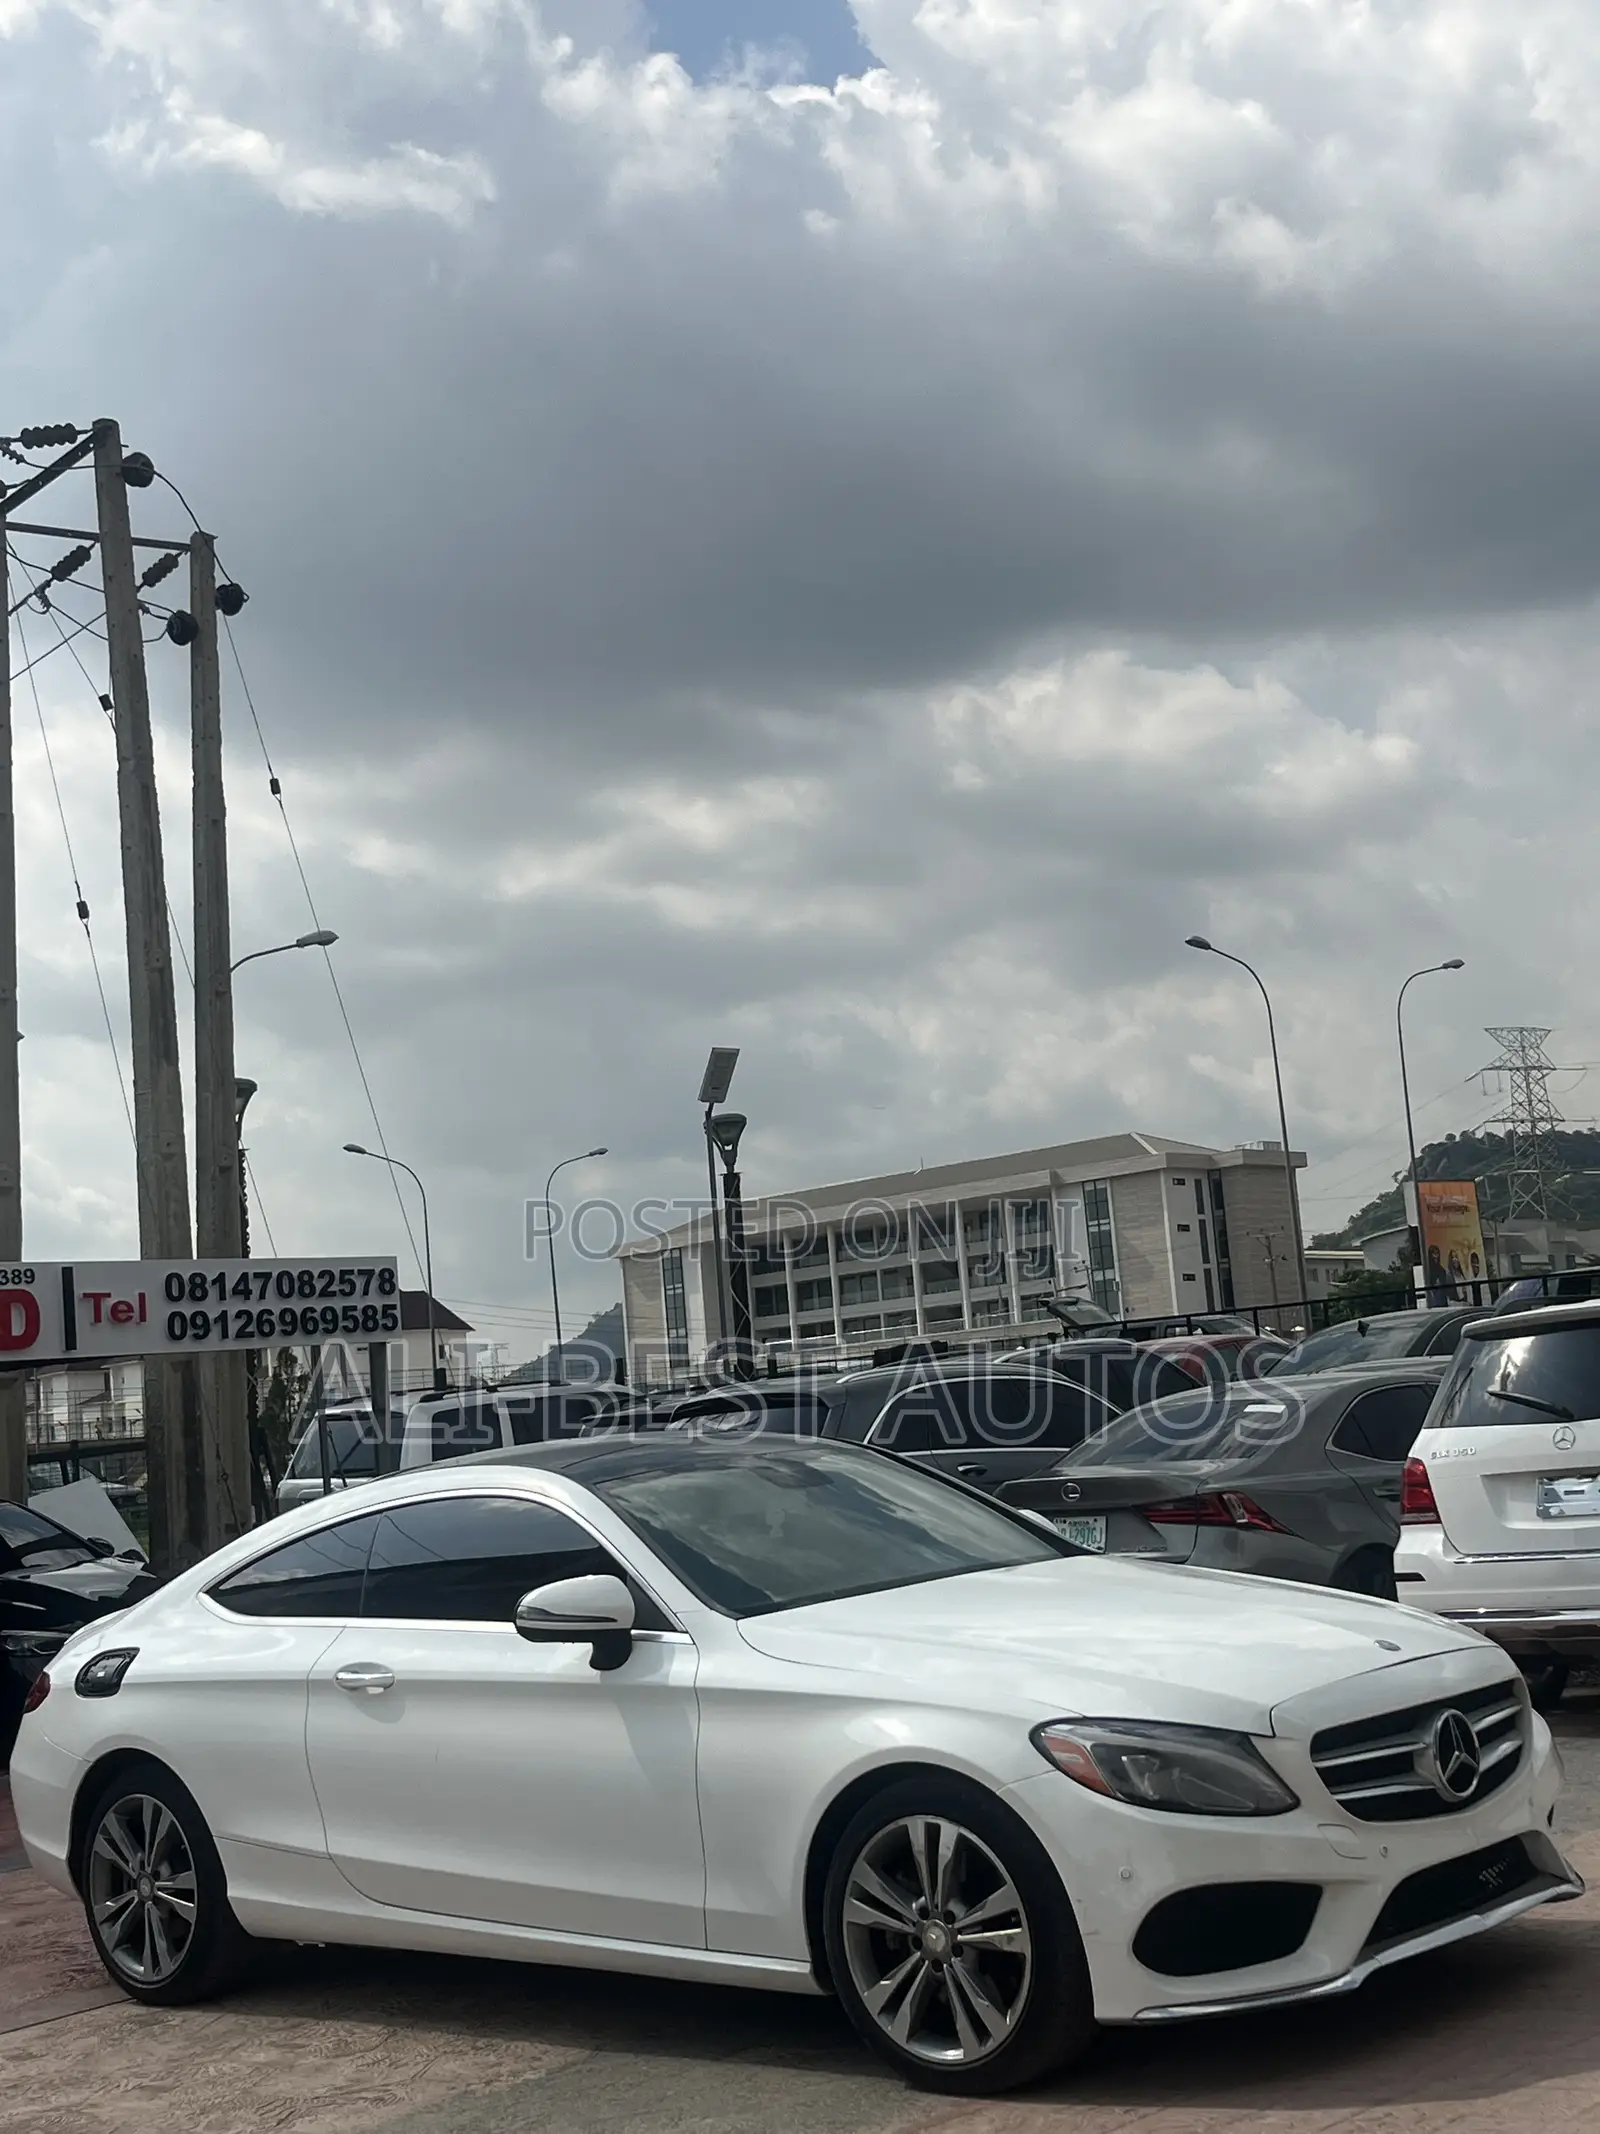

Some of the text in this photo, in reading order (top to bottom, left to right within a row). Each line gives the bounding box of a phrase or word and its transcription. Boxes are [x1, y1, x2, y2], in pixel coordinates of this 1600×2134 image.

[165, 1268, 396, 1301] 08147082578
[82, 1292, 147, 1323] Tel
[167, 1304, 398, 1341] 09126969585
